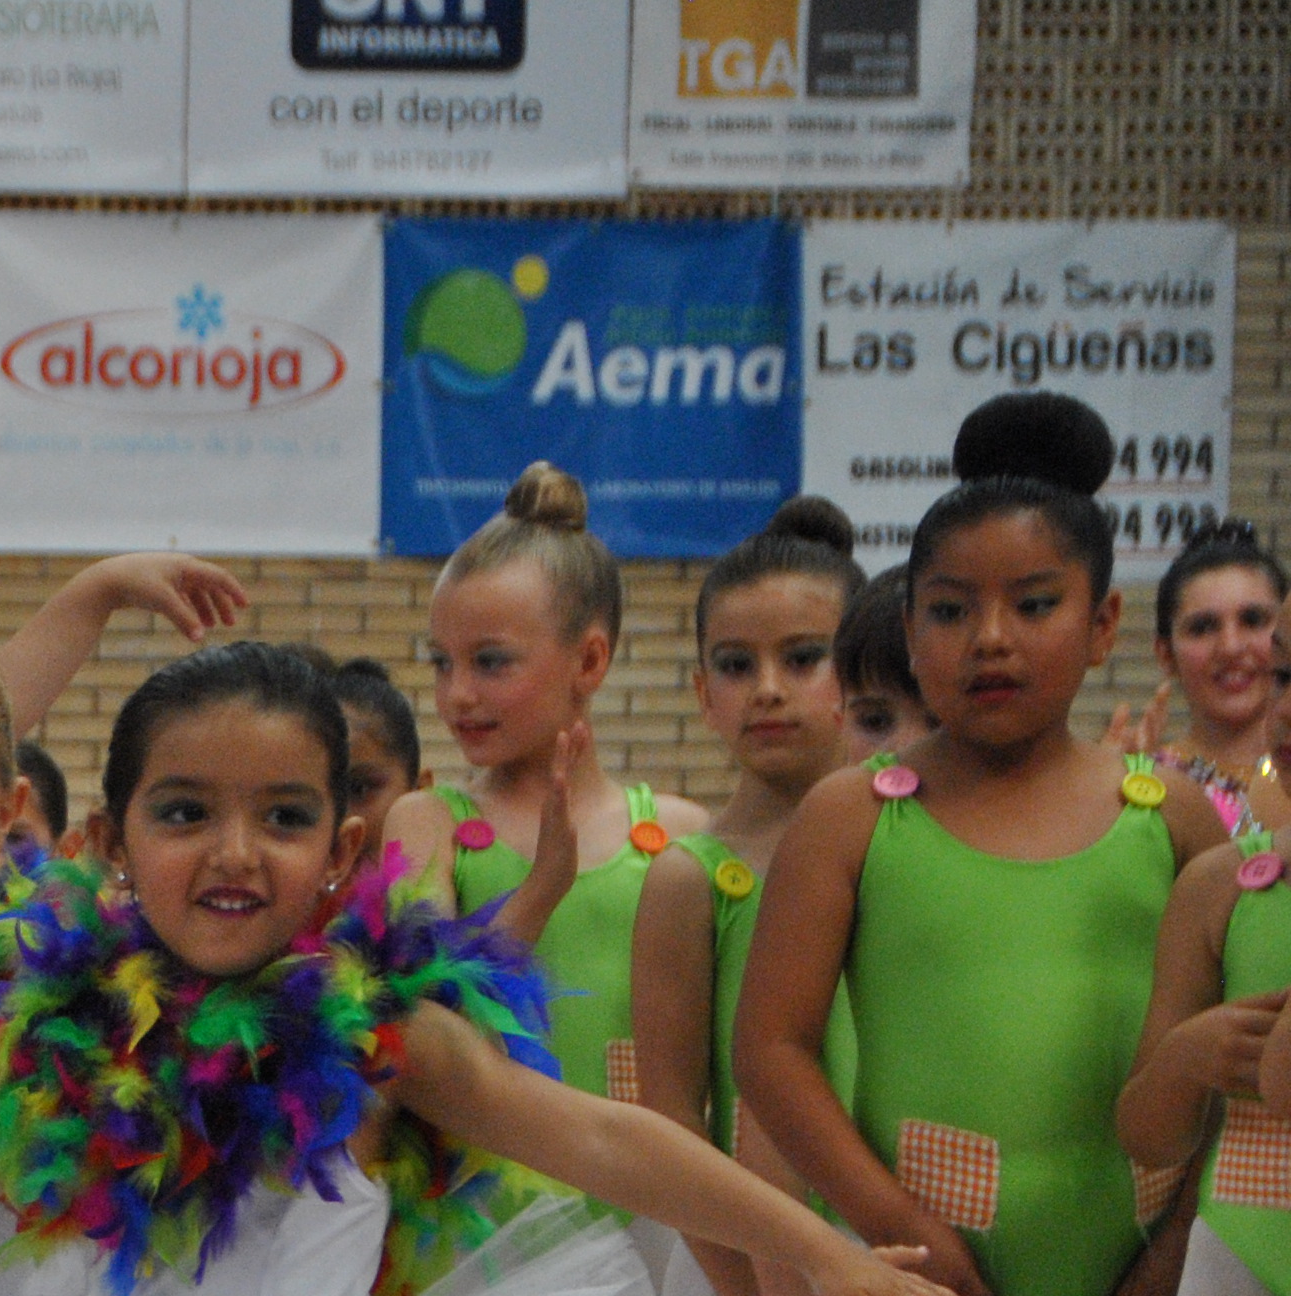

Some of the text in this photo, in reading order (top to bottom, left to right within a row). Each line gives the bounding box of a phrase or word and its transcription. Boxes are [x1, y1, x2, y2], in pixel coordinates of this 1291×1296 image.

[680, 36, 799, 92] TGA
[270, 89, 544, 134] con el deporte
[1000, 266, 1046, 308] de
[1063, 264, 1216, 310] Servicio
[39, 320, 302, 409] alcorioja
[531, 319, 788, 406] Aema
[817, 321, 917, 373] Las
[952, 319, 1215, 386] Cigüeñas
